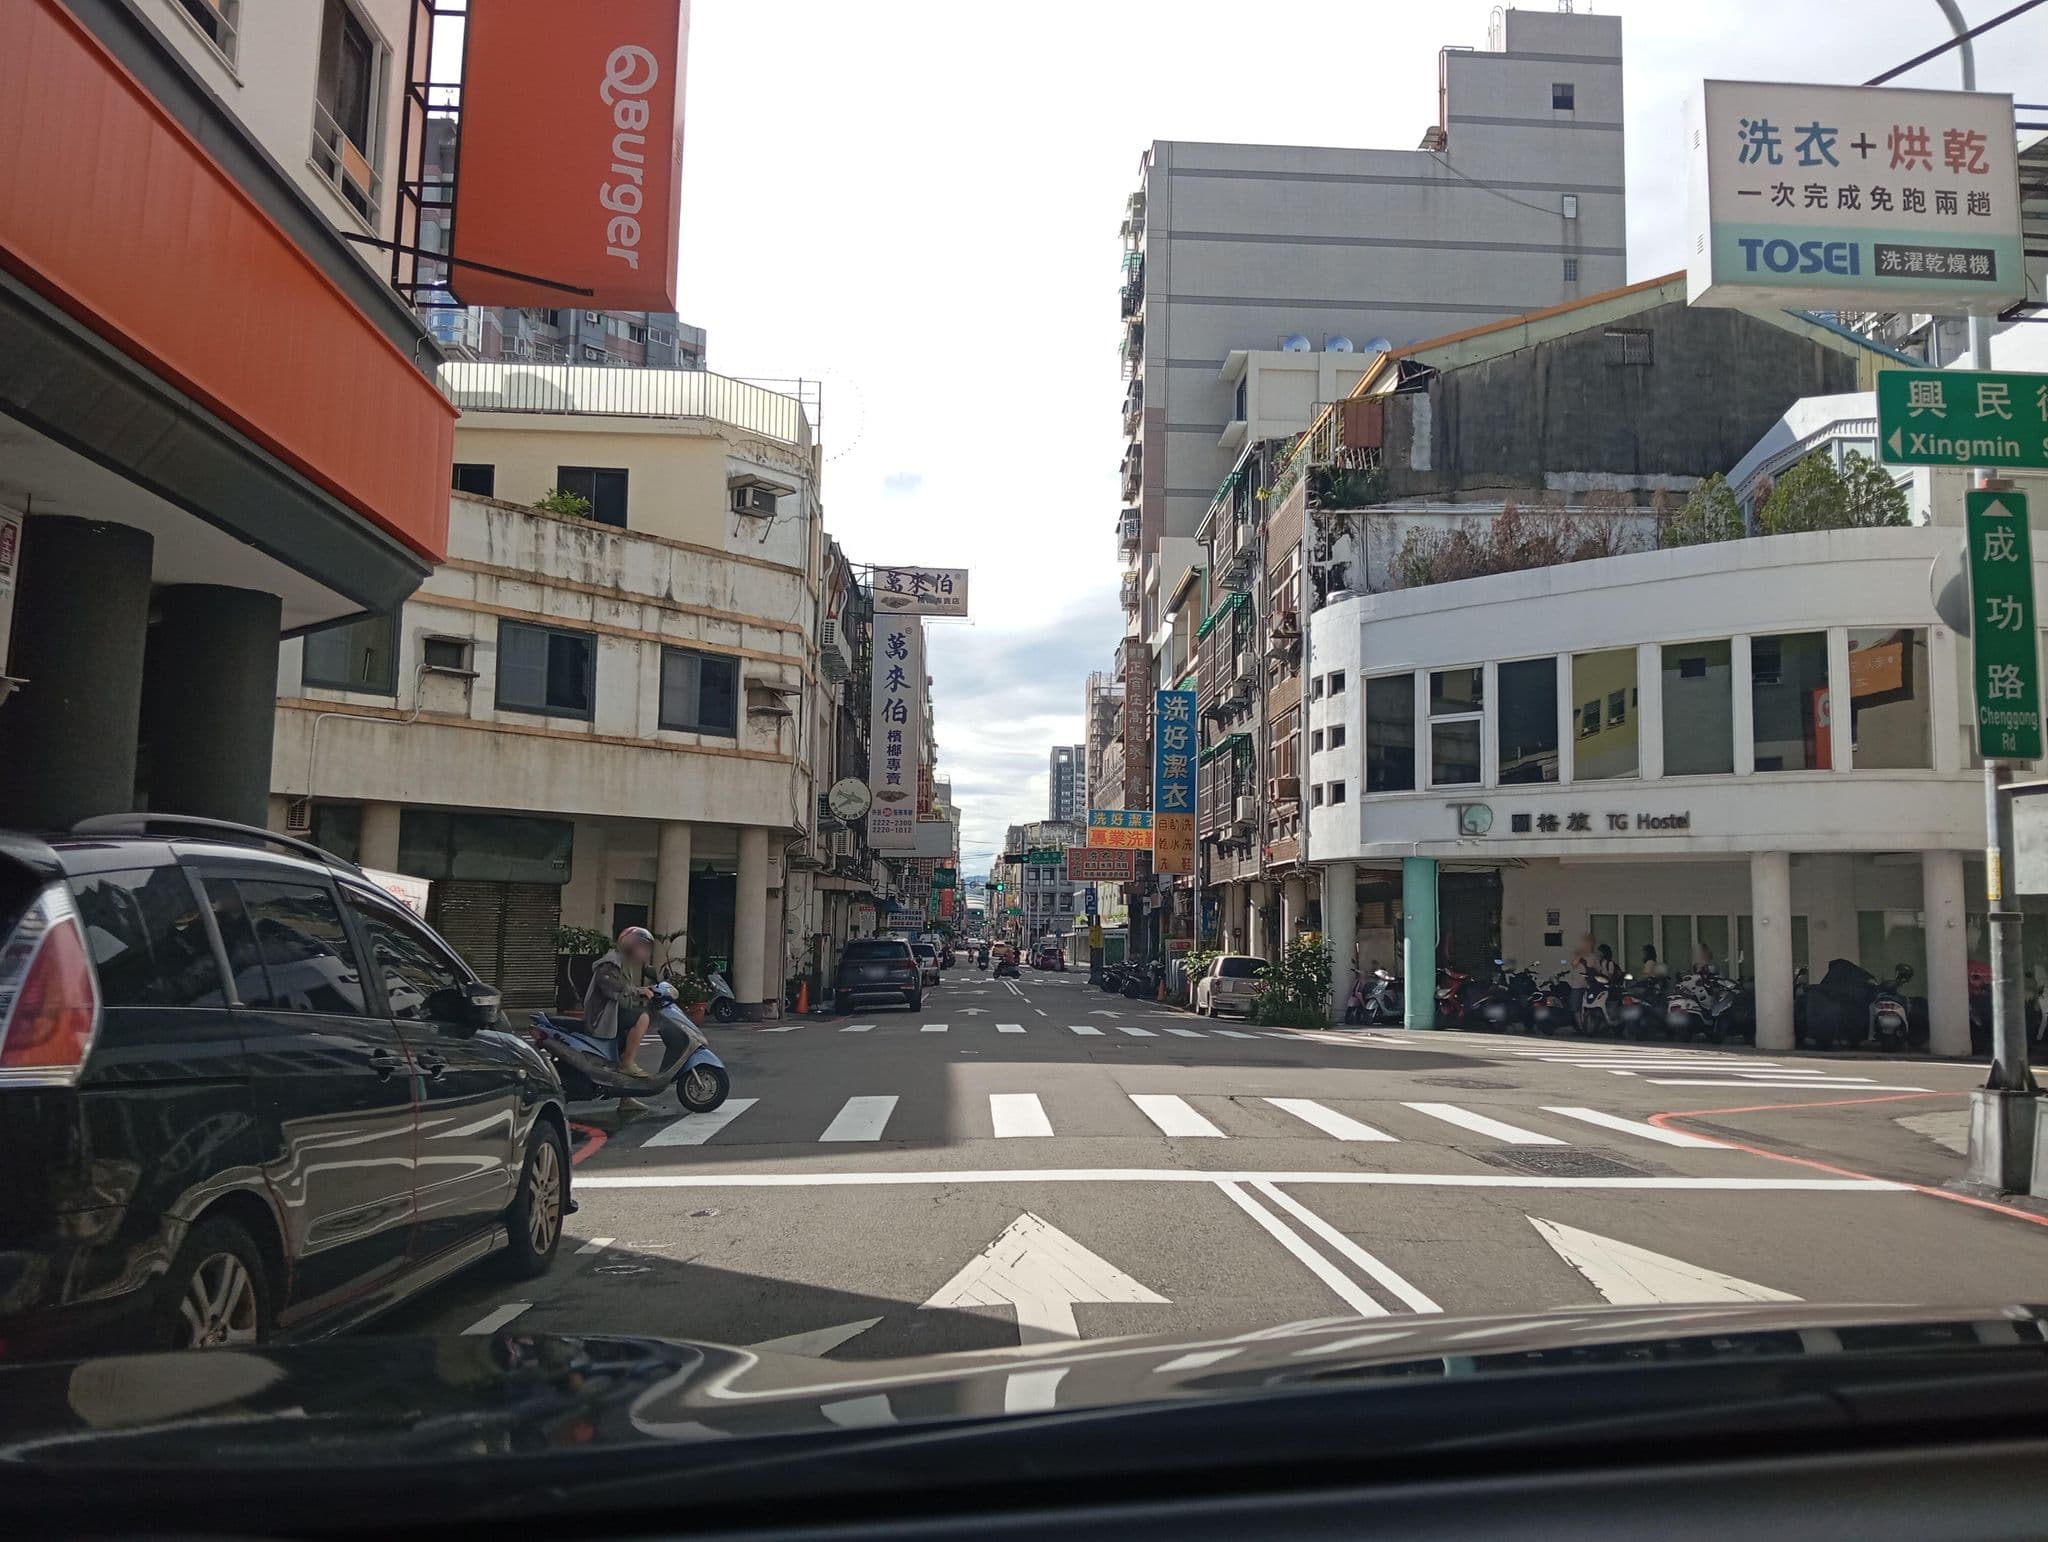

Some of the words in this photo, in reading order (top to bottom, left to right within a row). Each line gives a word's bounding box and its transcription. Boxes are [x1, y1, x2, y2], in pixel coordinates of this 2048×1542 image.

[600, 45, 658, 270] QBurger
[1737, 182, 1993, 217] 一次完成免跑兩趟
[1738, 238, 1860, 276] TOSEI
[1880, 249, 1992, 276] 洗濯乾燥機
[1910, 432, 2021, 461] Xingmin
[1984, 526, 2025, 701] 成功路
[881, 632, 911, 725] 萬來伯
[1980, 705, 2038, 732] Chenggong
[886, 729, 902, 786] 檳榔專賣
[1162, 695, 1189, 809] 洗好潔衣
[2002, 732, 2016, 752] Rd
[1607, 813, 1628, 831] TG
[1637, 811, 1691, 831] Hostel
